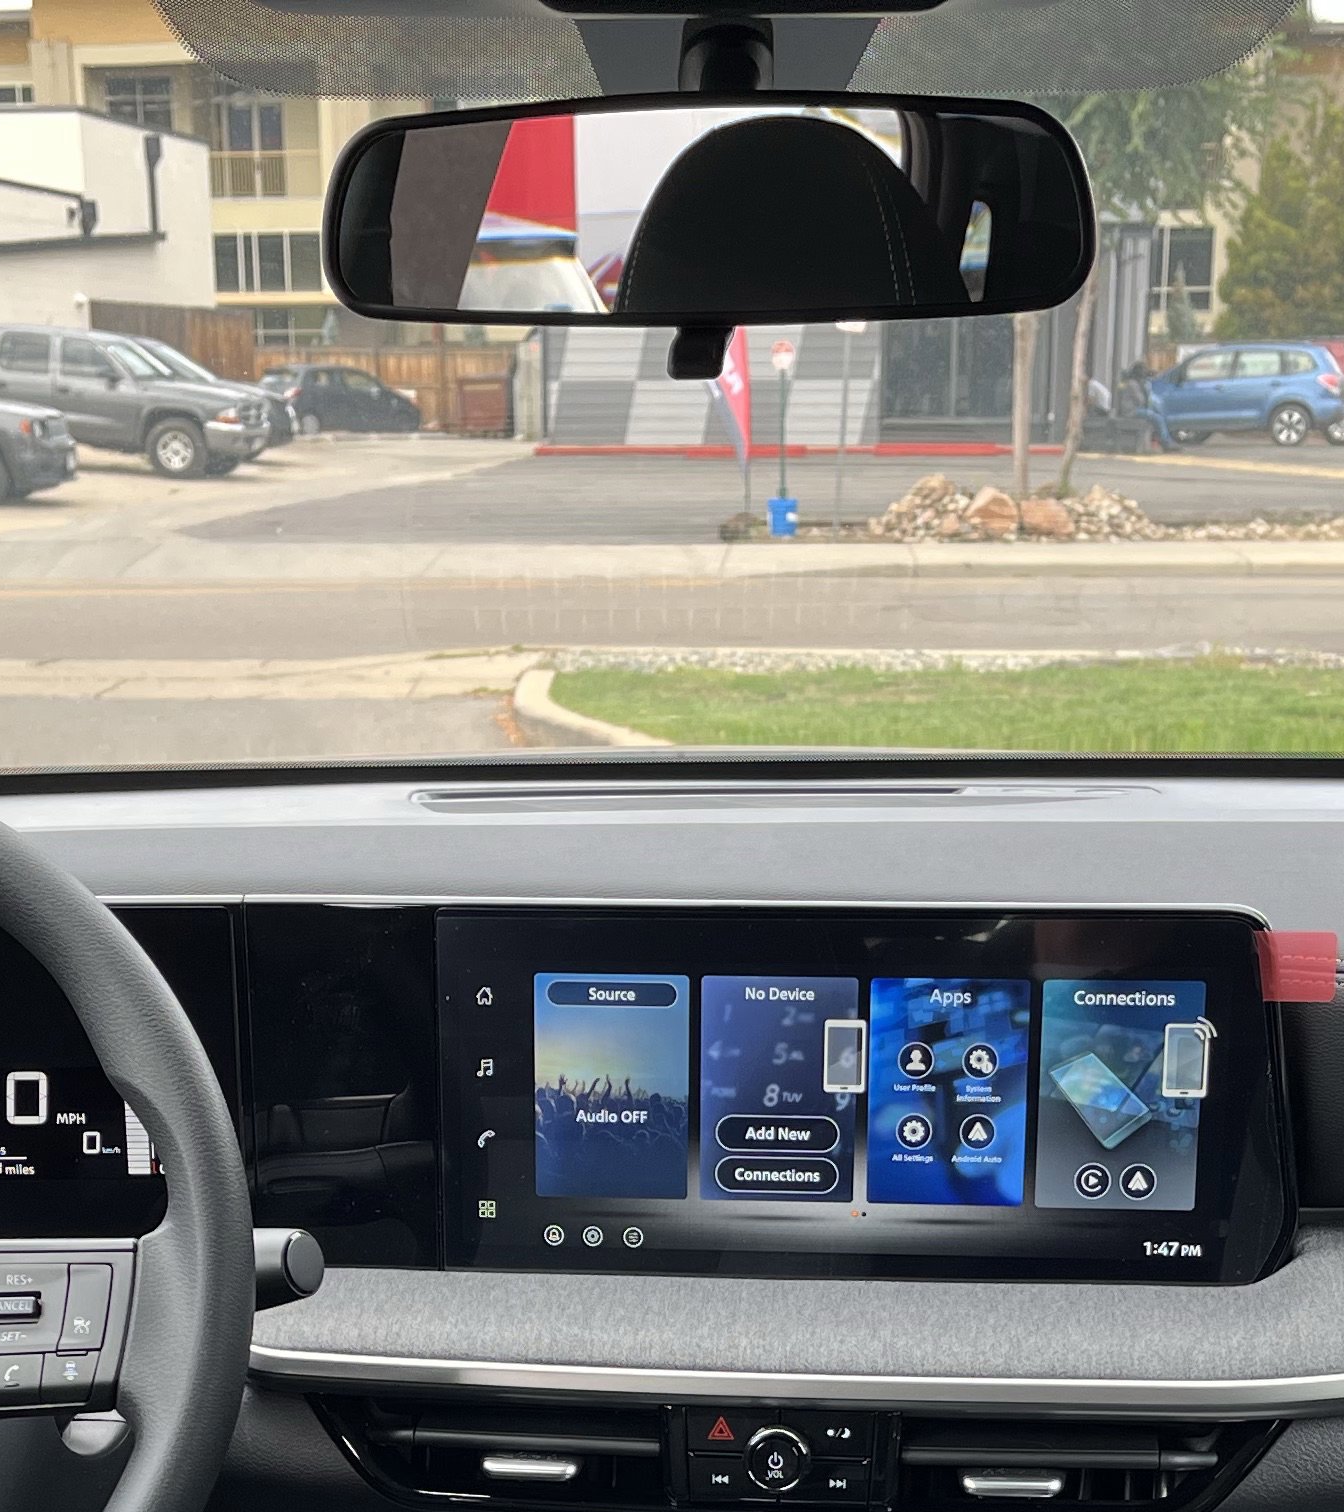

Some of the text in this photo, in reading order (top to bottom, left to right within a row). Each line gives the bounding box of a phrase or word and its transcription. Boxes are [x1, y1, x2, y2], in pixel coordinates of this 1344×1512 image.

[588, 987, 636, 1001] Source
[745, 987, 815, 1001] No Device
[930, 989, 971, 1006] Apps
[1074, 990, 1175, 1007] Connections
[894, 1083, 936, 1092] User Profile
[7, 1071, 86, 1125] 0 MPH
[956, 1095, 1001, 1104] Information
[576, 1109, 648, 1124] Audio OFF
[745, 1126, 810, 1141] Add New
[892, 1154, 933, 1164] All Settings
[951, 1154, 1002, 1164] Android Auto
[4, 1163, 35, 1175] miles
[734, 1167, 821, 1183] Connections
[1143, 1241, 1202, 1257] 1:47 PM
[6, 1274, 33, 1285] RES+
[767, 1469, 784, 1478] VOL
